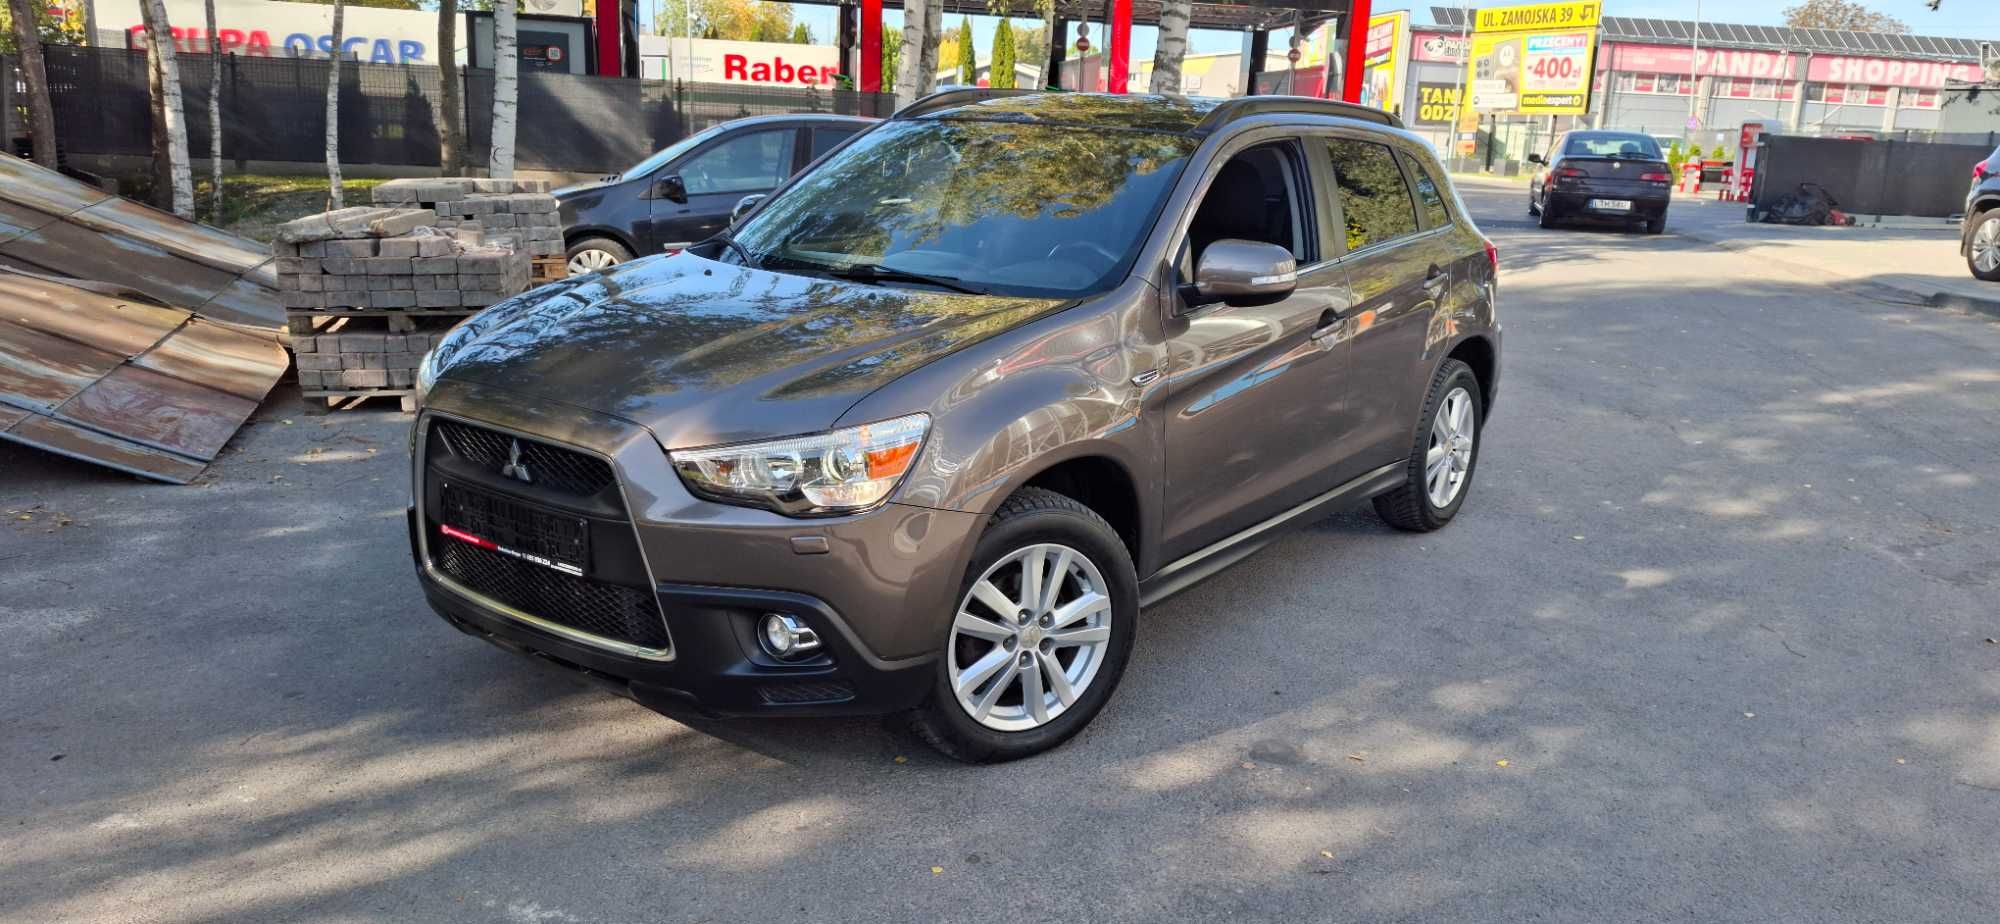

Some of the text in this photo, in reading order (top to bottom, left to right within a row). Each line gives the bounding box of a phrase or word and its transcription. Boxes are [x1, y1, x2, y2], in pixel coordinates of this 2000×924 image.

[1483, 7, 1574, 27] UL. ZAMOJSKA 39
[283, 33, 426, 64] OSCAR
[1695, 50, 1969, 87] PANDA SHOPPING
